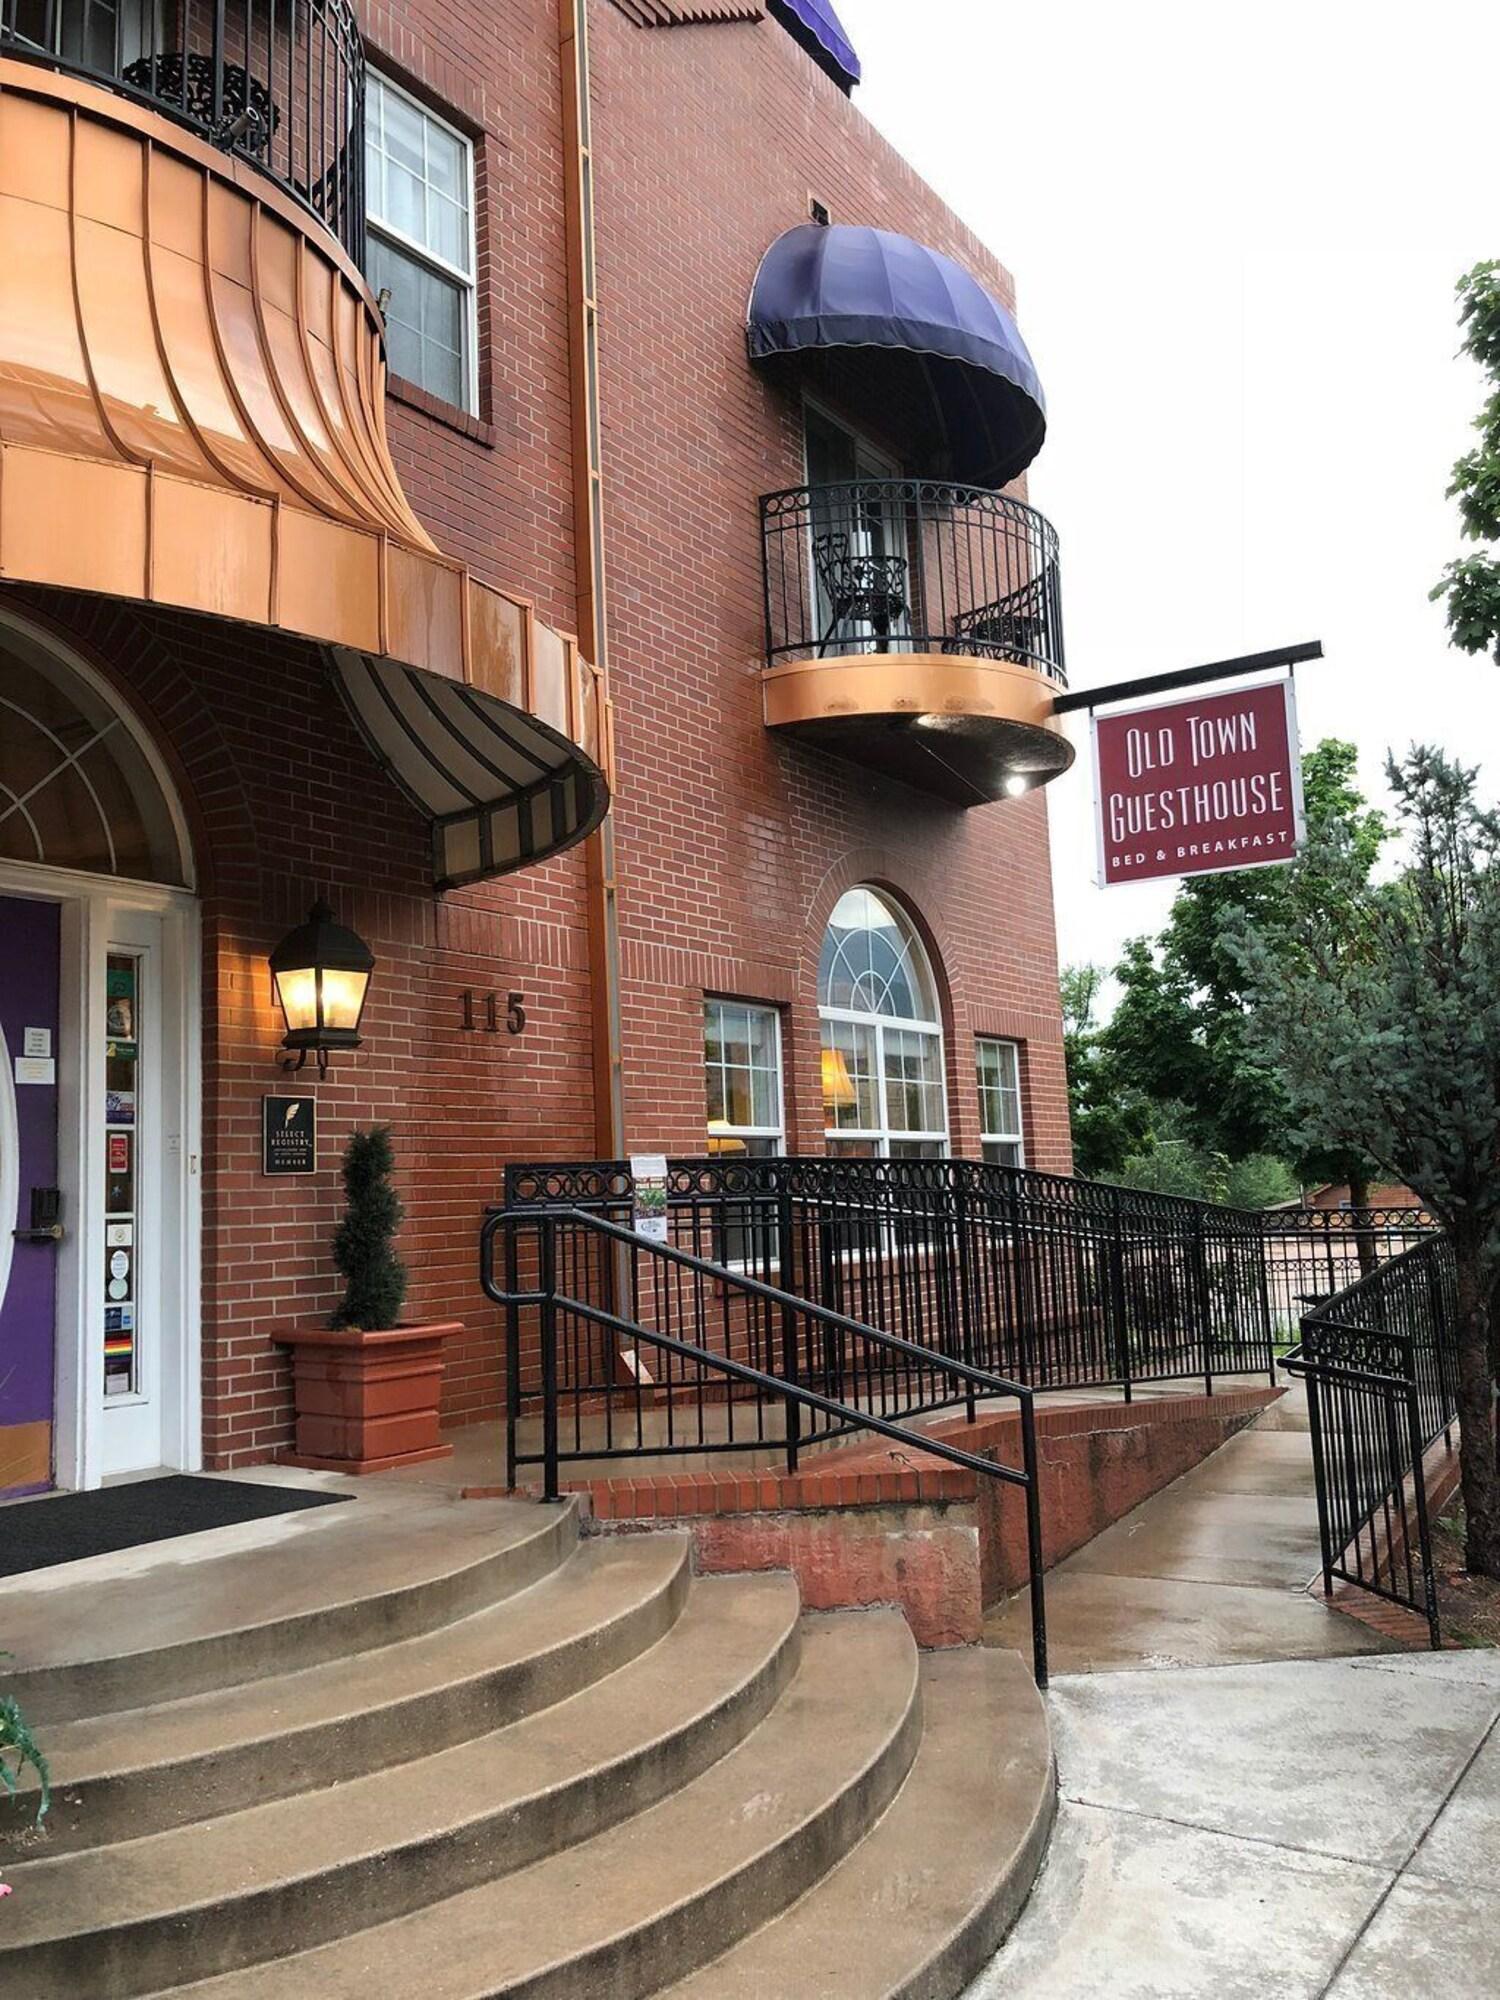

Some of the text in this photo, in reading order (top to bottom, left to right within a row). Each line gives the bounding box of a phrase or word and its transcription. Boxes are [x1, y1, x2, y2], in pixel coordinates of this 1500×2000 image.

[1126, 711, 1257, 778] OLD TOWN
[1109, 771, 1285, 843] GUESTHOUSE
[1112, 831, 1288, 867] BED & BREAKFAST
[458, 989, 526, 1034] 115
